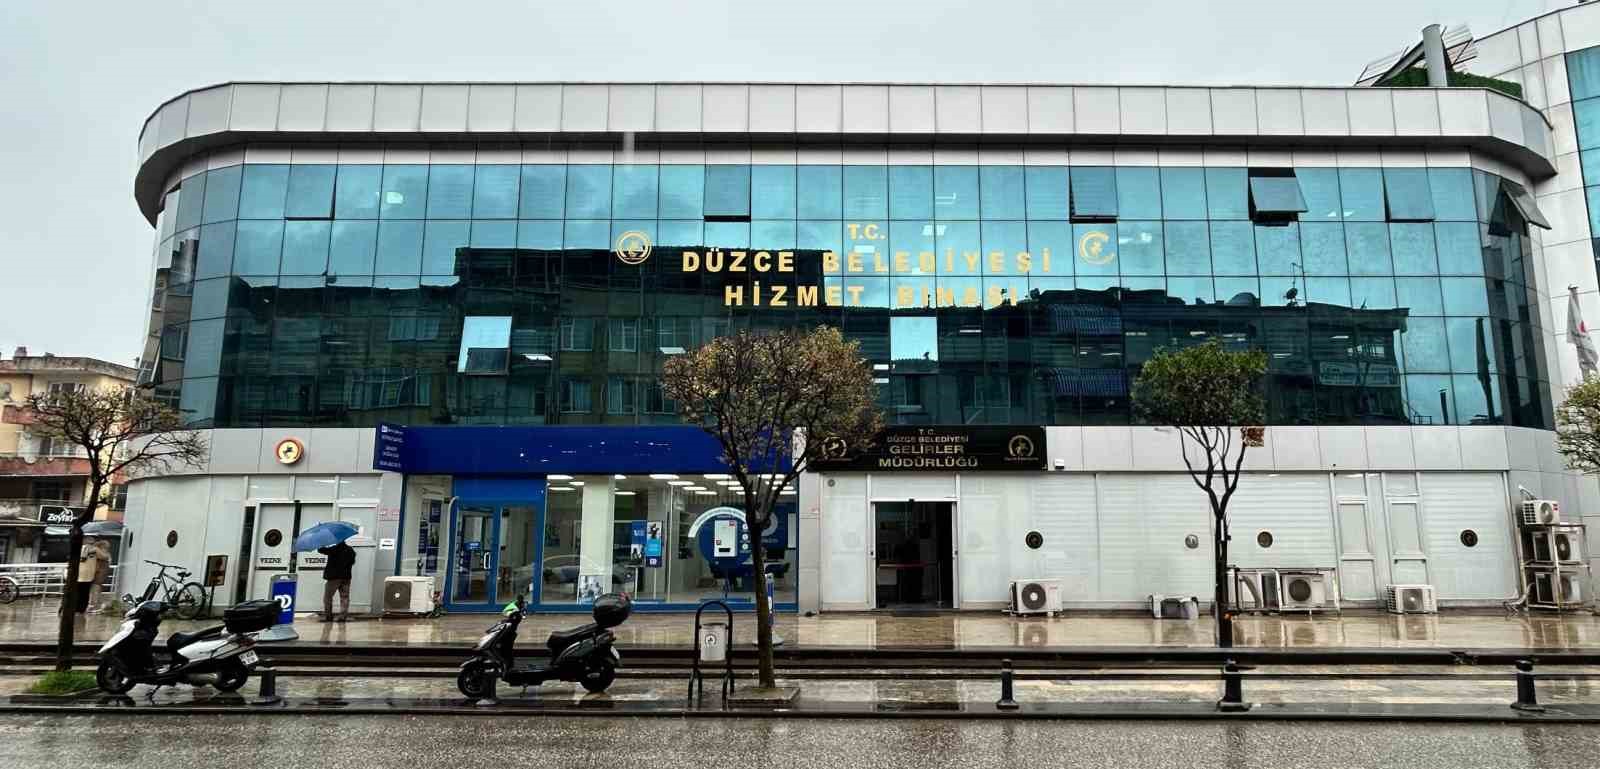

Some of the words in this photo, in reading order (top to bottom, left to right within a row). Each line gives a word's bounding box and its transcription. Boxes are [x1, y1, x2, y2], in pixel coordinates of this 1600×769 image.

[848, 224, 886, 240] T.C.
[682, 247, 794, 272] DÜZCE
[822, 247, 1051, 273] BELEDİYESİ
[724, 281, 865, 306] HİZMET
[889, 444, 964, 454] GELİRLER
[879, 456, 978, 467] MÜDÜRLÜĞÜ
